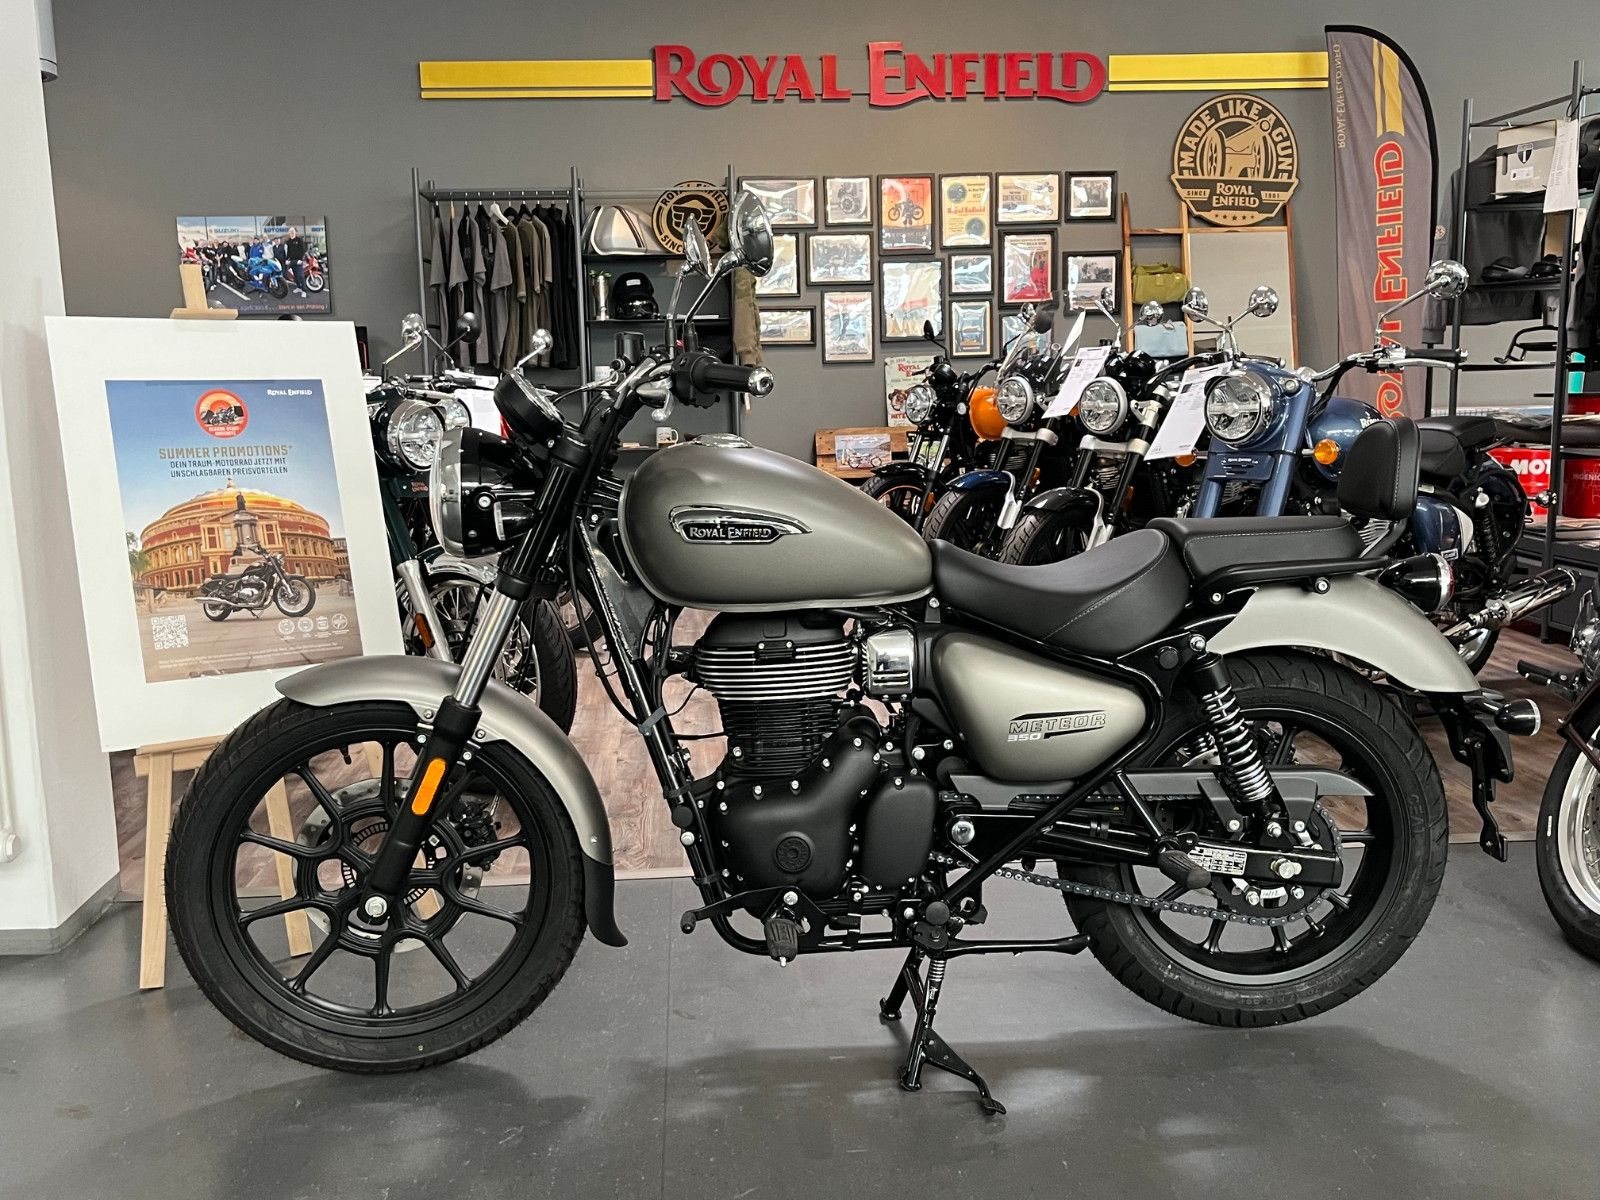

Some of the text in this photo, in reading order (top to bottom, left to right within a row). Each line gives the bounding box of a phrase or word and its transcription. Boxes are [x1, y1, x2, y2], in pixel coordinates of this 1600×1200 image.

[654, 41, 1106, 107] ROYAL ENFIELD
[1180, 109, 1216, 168] MADE
[1216, 99, 1263, 121] LIKE
[1271, 126, 1293, 171] GUN
[1216, 182, 1255, 196] ROYAL
[1212, 195, 1260, 208] ENFIELD
[660, 234, 687, 254] SINC
[159, 447, 210, 460] SUMMER
[170, 456, 287, 469] DEIN TRAUM-MOTORRAD JETZT MIT
[170, 466, 288, 478] UNSCHLAGBAREN PREISVORTEILEN
[689, 526, 771, 539] ROYAL ENFIELD
[1008, 713, 1106, 734] METEOR
[1007, 733, 1042, 742] 350
